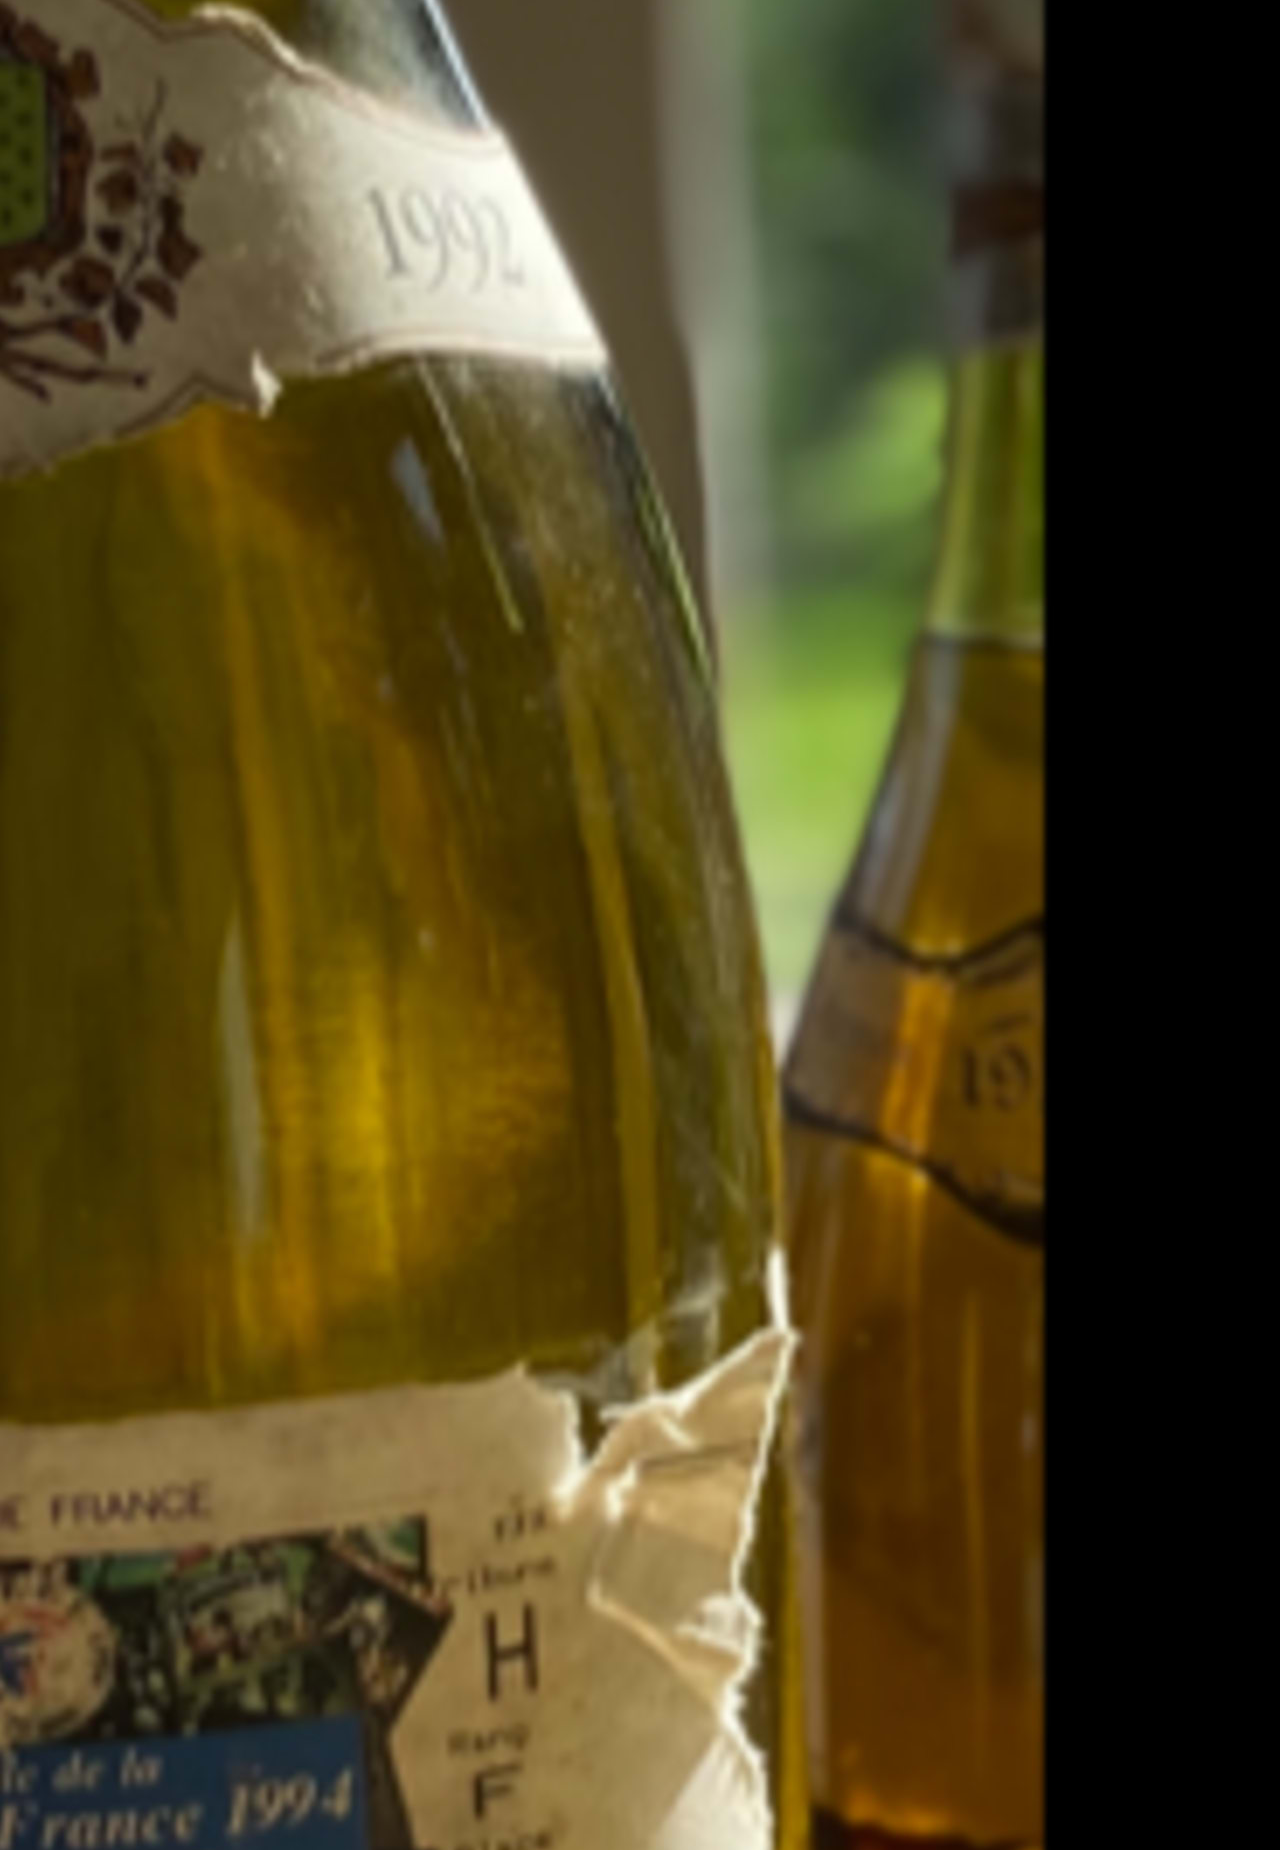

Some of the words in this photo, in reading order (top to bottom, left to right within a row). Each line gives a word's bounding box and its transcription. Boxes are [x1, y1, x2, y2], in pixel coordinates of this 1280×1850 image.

[367, 186, 526, 293] 1992
[49, 1480, 212, 1526] FRANCE
[484, 1602, 538, 1703] H
[52, 1752, 106, 1792] de
[119, 1748, 161, 1788] la
[226, 1764, 356, 1837] 1994
[472, 1761, 523, 1821] F
